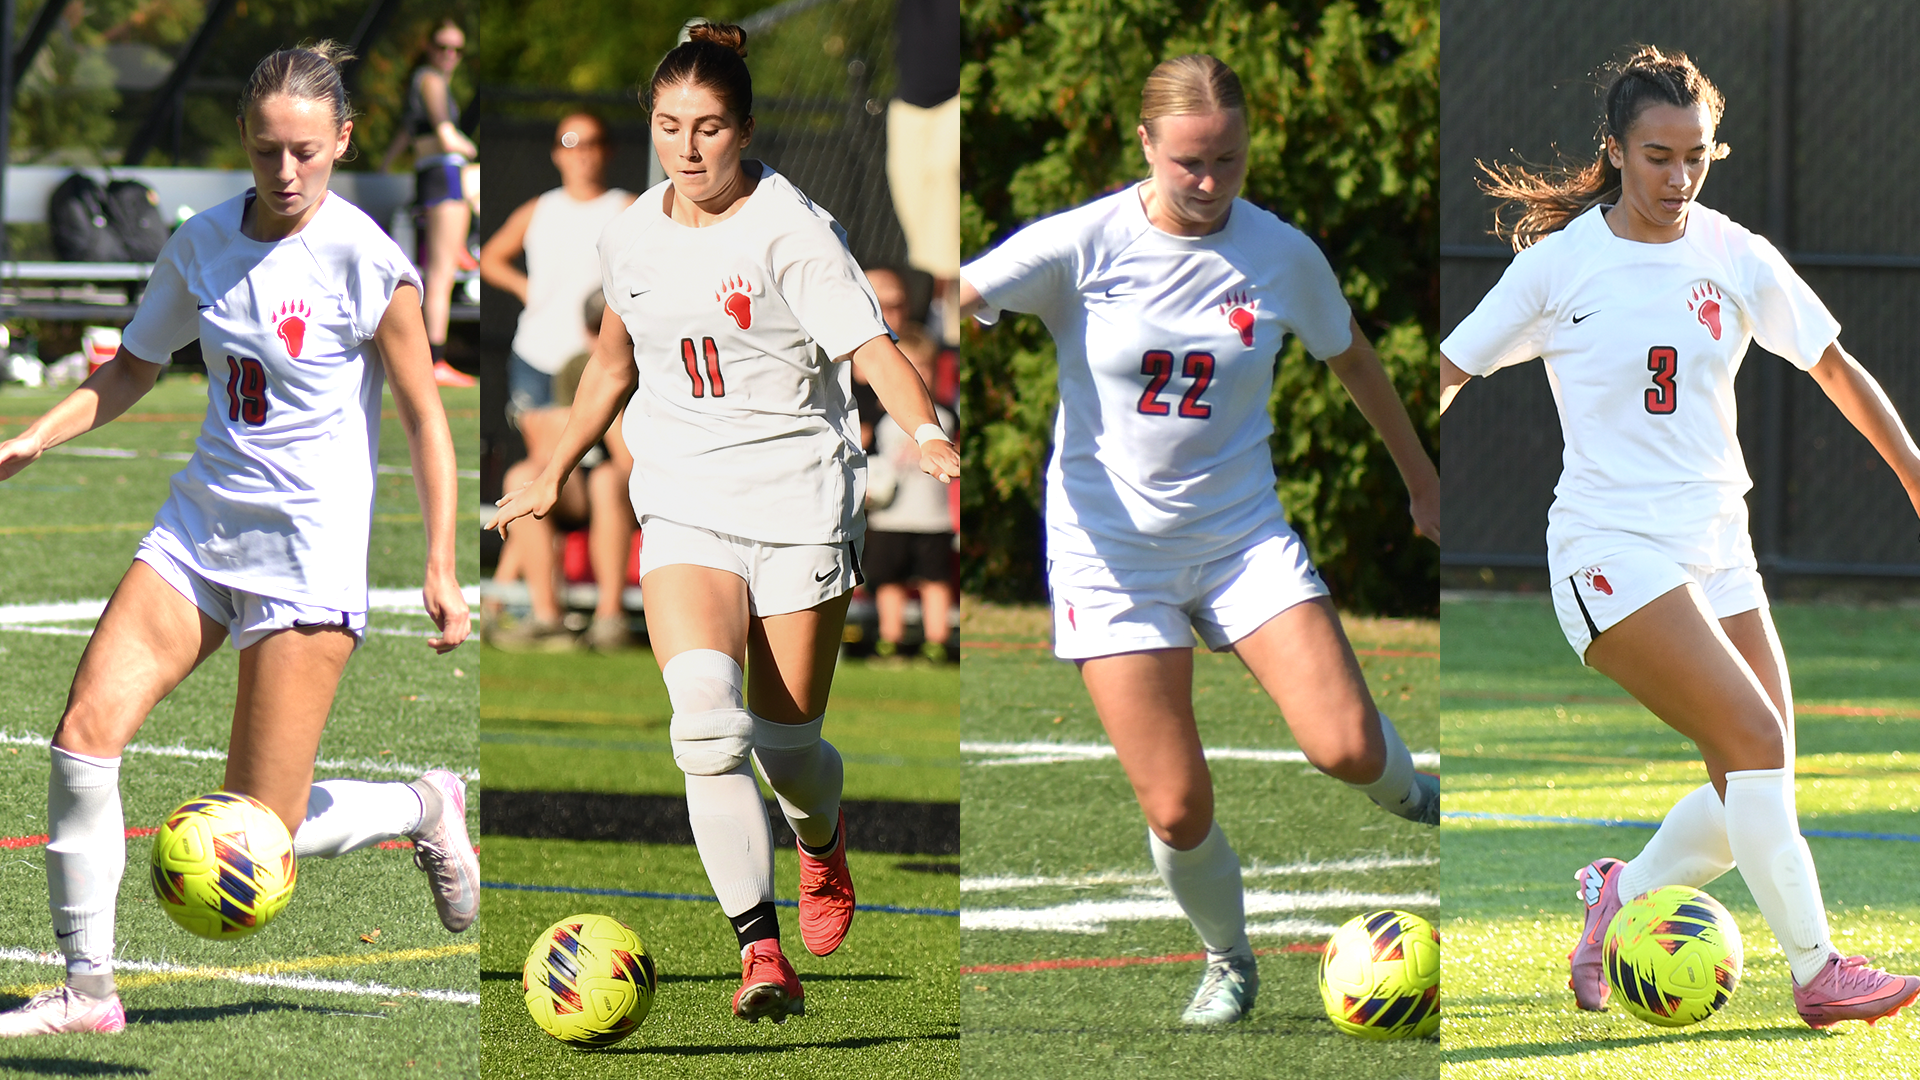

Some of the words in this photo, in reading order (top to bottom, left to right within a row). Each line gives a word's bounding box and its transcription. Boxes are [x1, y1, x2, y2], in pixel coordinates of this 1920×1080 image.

[227, 355, 268, 426] 19
[681, 336, 725, 398] 11
[1137, 350, 1215, 419] 22
[1645, 346, 1677, 414] 3
